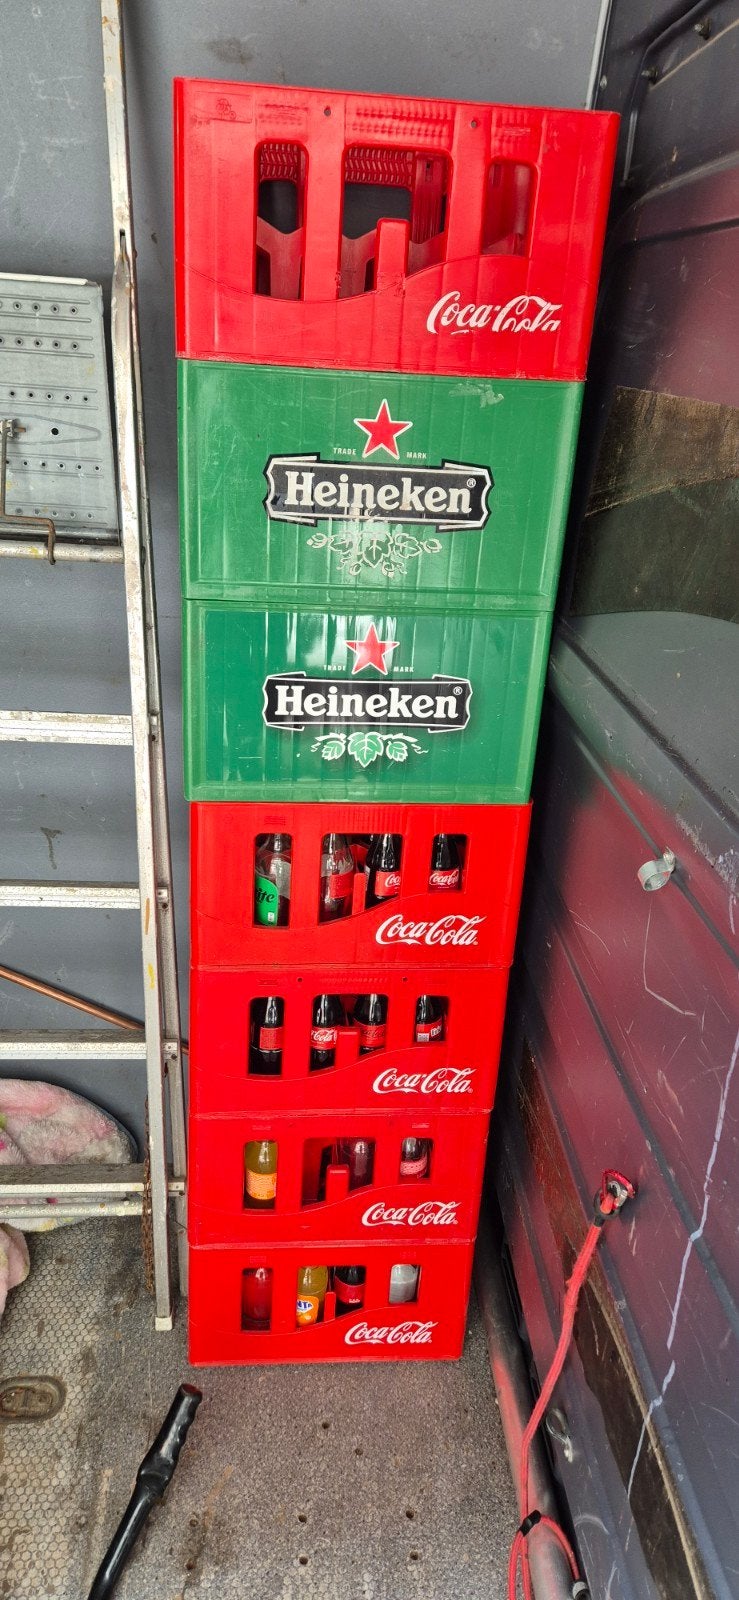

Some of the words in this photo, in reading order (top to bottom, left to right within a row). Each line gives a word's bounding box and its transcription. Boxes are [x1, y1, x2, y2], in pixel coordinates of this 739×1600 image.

[333, 447, 357, 455] TRADE
[406, 451, 428, 459] MARK
[393, 665, 415, 673] MARK
[375, 914, 486, 946] Coca-Cola
[372, 1067, 476, 1094] Coca-Cola
[362, 1201, 461, 1227] Coca-Cola
[344, 1321, 438, 1346] Coca-Cola
